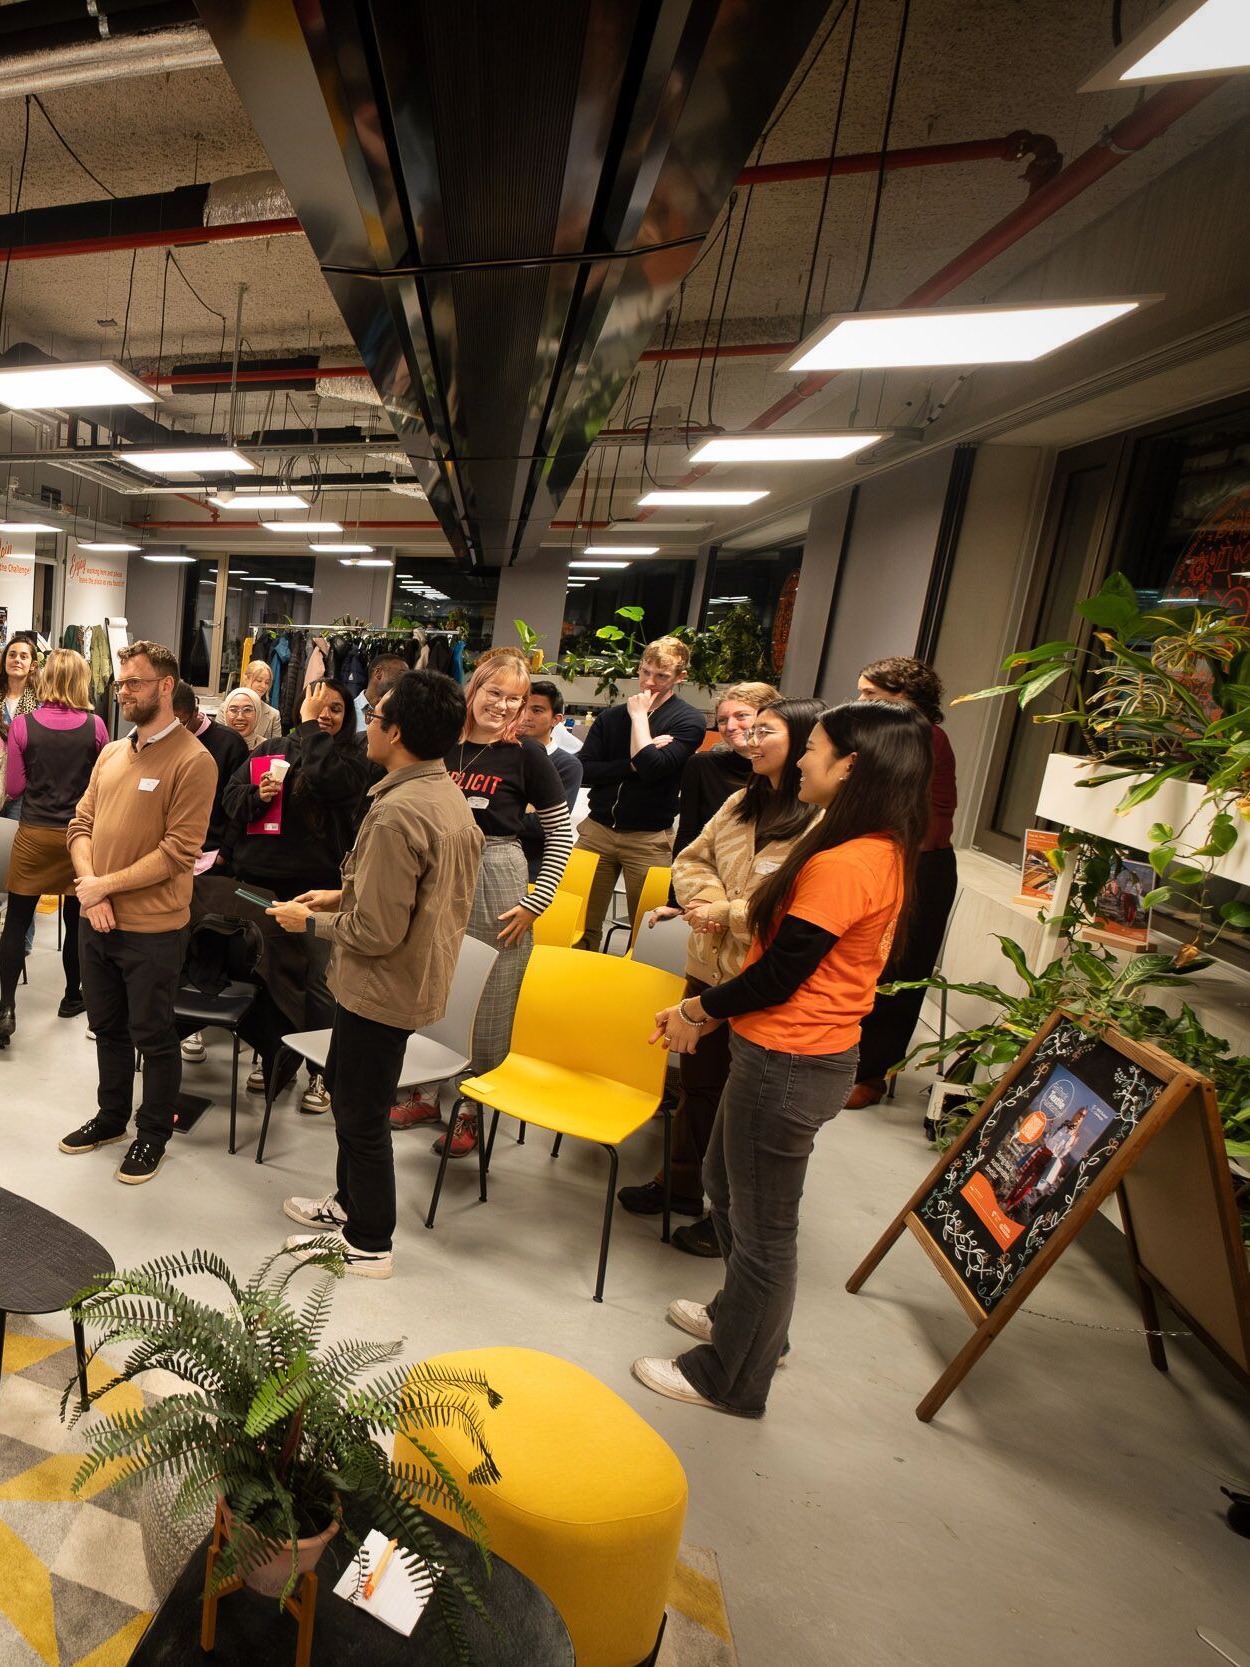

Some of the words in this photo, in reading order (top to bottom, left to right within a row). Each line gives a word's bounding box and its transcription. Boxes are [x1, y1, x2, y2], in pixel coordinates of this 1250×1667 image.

[0, 563, 7, 572] the
[445, 770, 503, 795] PLICIT
[1048, 1090, 1066, 1110] Textile
